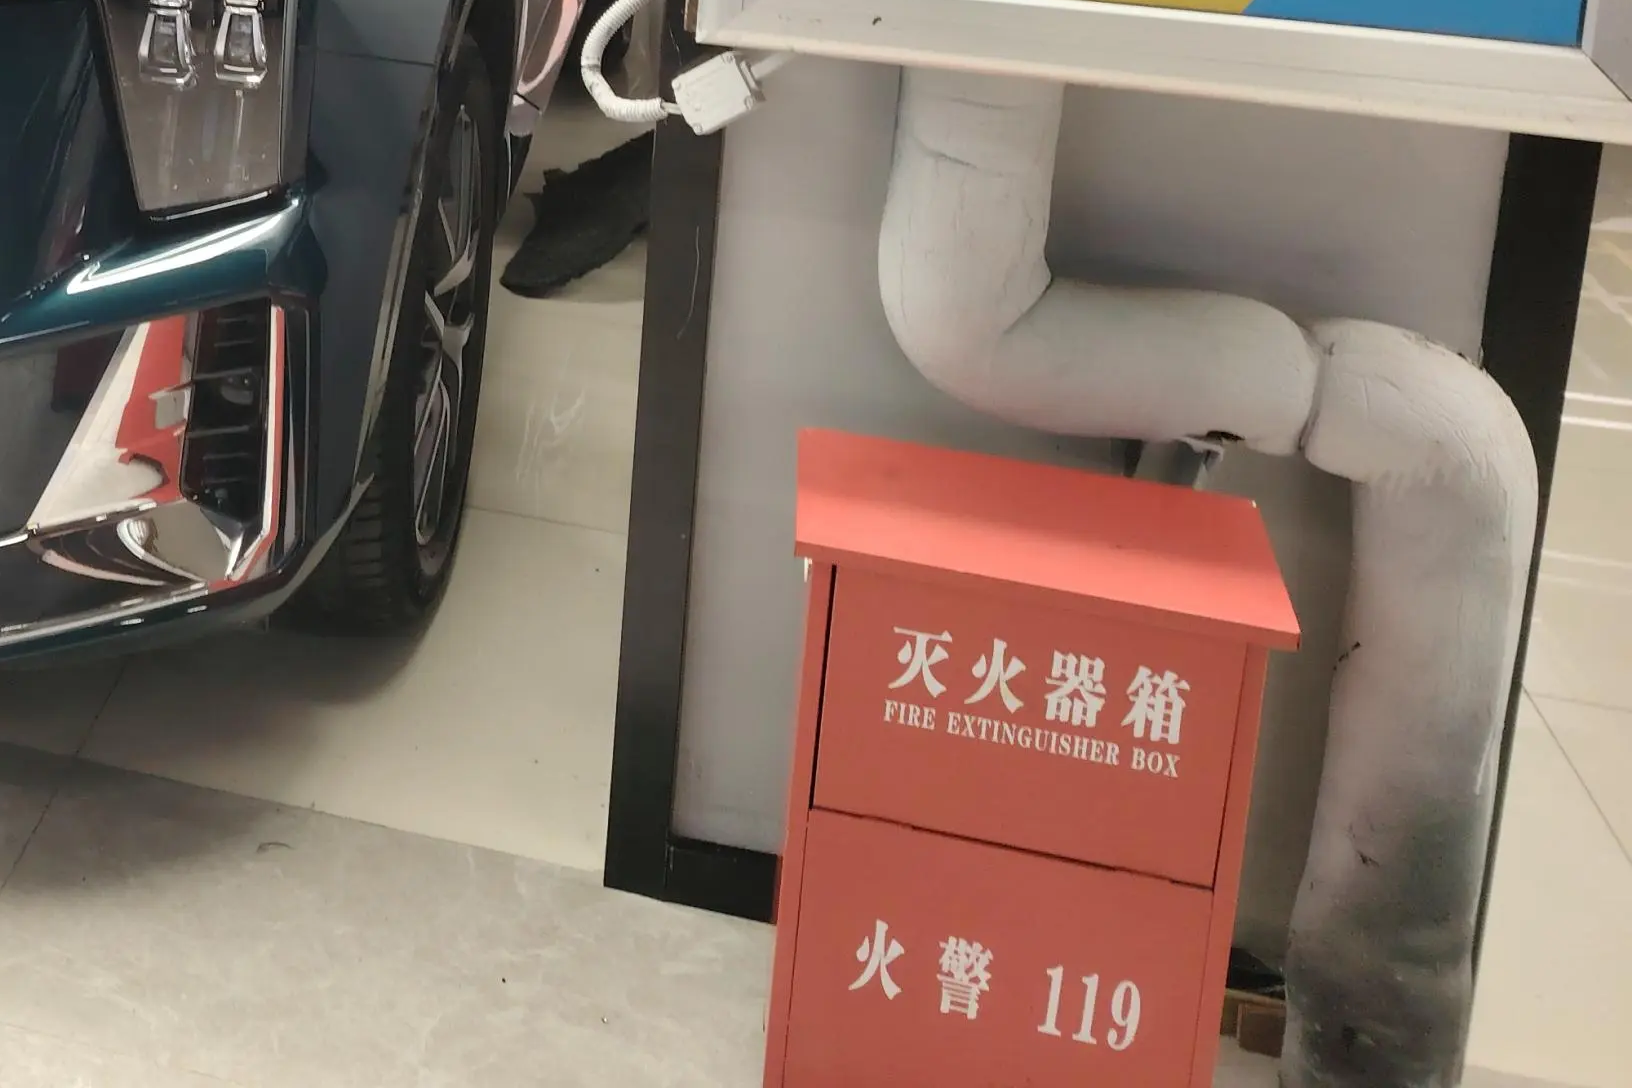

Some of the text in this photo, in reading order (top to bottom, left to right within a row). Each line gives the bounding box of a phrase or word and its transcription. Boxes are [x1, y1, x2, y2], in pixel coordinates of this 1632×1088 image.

[887, 624, 1192, 746] 灭火器箱
[884, 699, 1182, 779] FIRE EXTINGUISHER BOX
